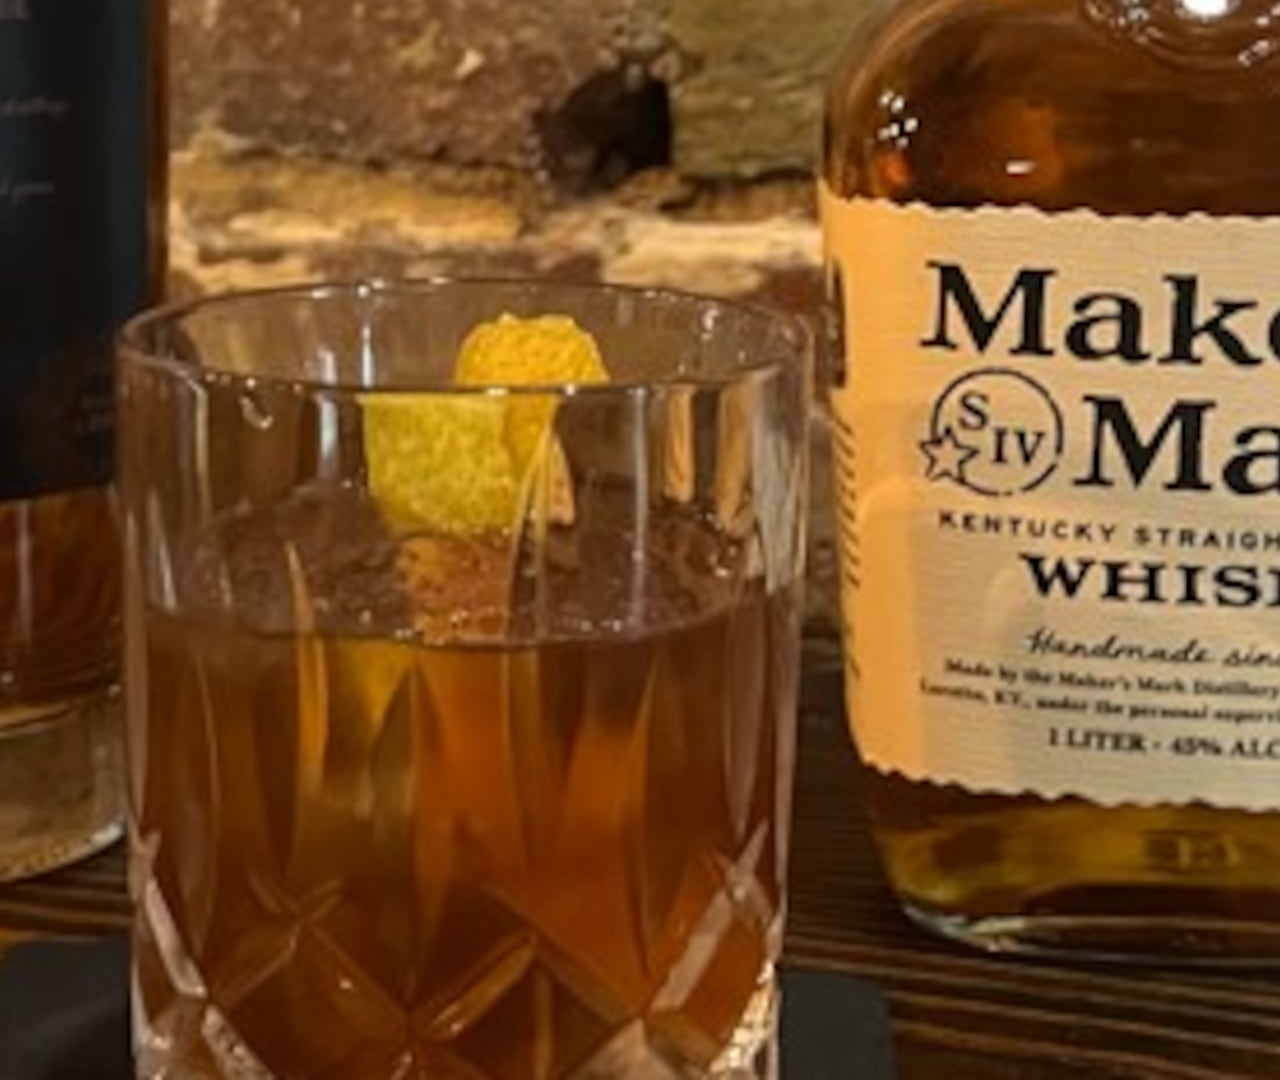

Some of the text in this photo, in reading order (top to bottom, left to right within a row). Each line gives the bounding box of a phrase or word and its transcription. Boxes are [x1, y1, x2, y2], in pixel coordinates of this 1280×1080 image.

[959, 389, 1045, 464] S IV
[938, 509, 1116, 543] KENTUCKY
[1025, 625, 1216, 664] Handmade
[944, 658, 993, 678] Made
[999, 664, 1018, 685] by
[1023, 666, 1053, 684] the
[1059, 671, 1132, 691] Maker's
[1137, 675, 1186, 693] Mark
[1036, 696, 1089, 711] under
[1094, 698, 1124, 715] the
[1129, 702, 1208, 720] personal
[1049, 726, 1059, 747] 1
[1067, 726, 1147, 752] LITER
[1170, 735, 1223, 757] 45%
